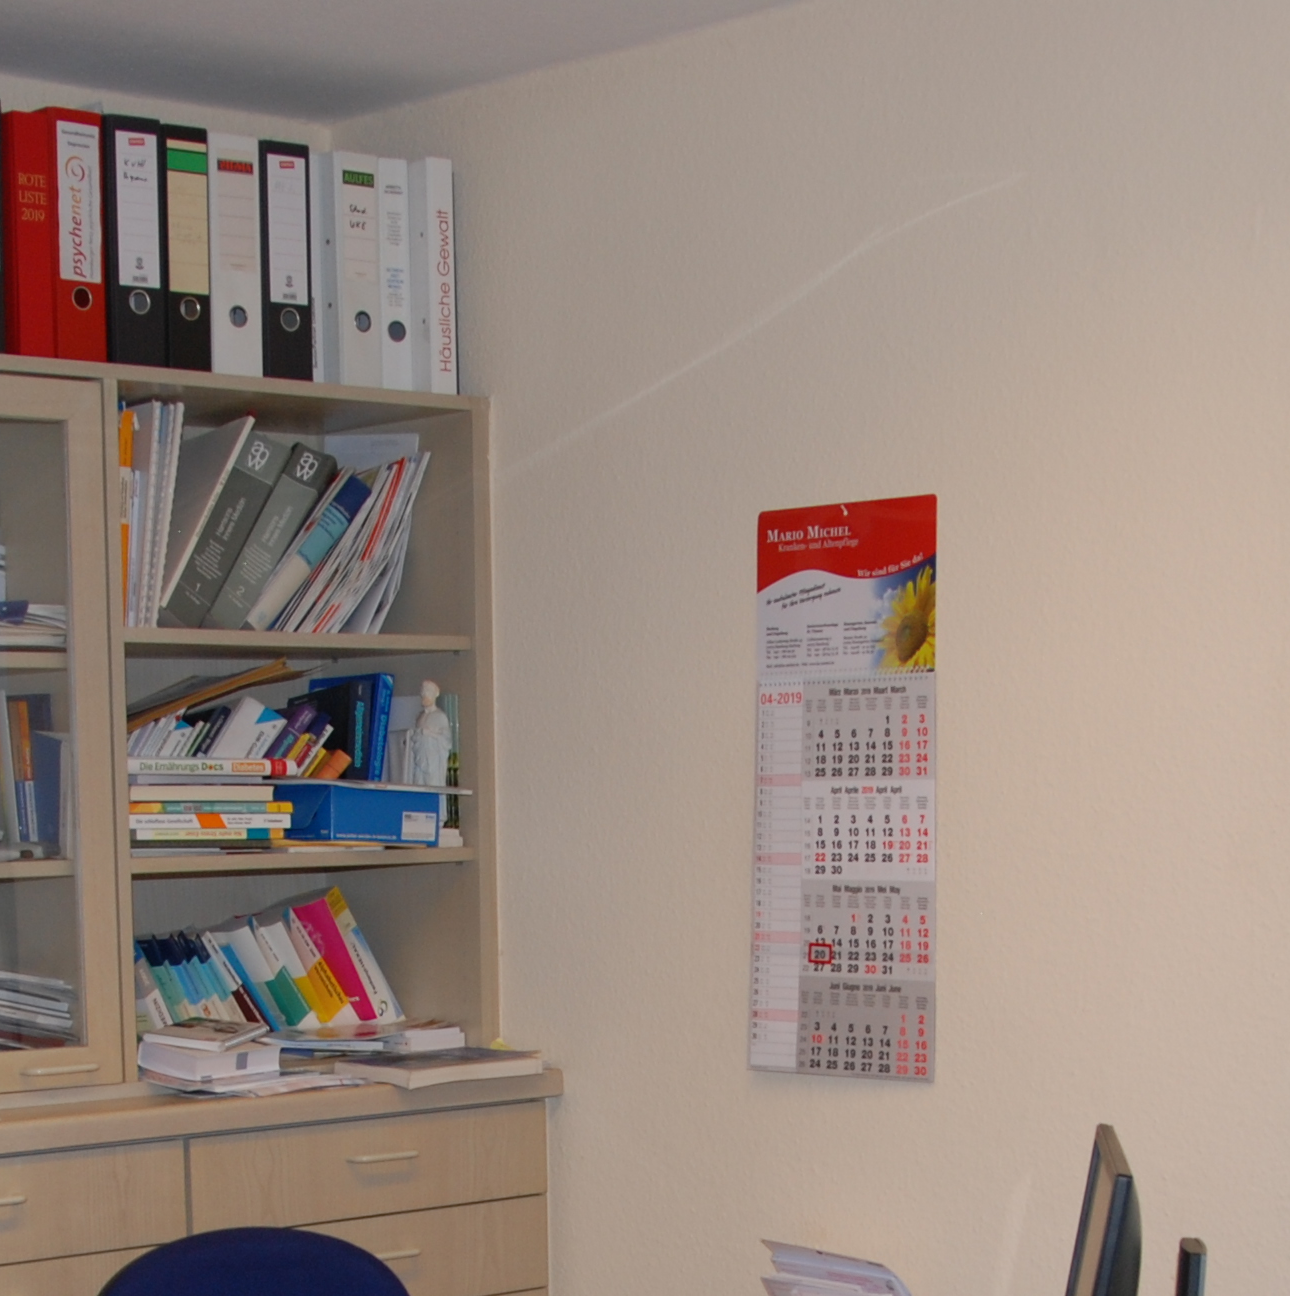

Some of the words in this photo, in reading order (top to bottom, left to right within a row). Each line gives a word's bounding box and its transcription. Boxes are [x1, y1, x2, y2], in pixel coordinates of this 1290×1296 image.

[18, 172, 47, 188] ROTE
[344, 172, 374, 186] AULFES
[19, 190, 47, 205] LISTE
[22, 208, 46, 222] 2019
[69, 185, 87, 279] psychenet
[436, 209, 450, 277] Gewalt
[439, 282, 452, 373] Häusliche
[767, 529, 804, 543] MARIO
[807, 525, 852, 540] MICHEL
[809, 540, 822, 550] und
[823, 538, 859, 550] Altenpflege
[857, 569, 871, 577] Wir
[872, 567, 887, 577] sind
[888, 564, 899, 574] für
[900, 560, 911, 571] Sie
[912, 552, 924, 564] da!
[760, 692, 802, 705] 04-2019
[816, 743, 826, 752] 11
[832, 743, 843, 751] 12
[849, 742, 860, 751] 13
[865, 742, 876, 751] 14
[882, 741, 893, 750] 15
[899, 741, 911, 750] 16
[917, 740, 928, 749] 17
[139, 762, 153, 771] Die
[155, 762, 200, 773] Ernährungs
[233, 762, 265, 772] Diabetes
[815, 767, 826, 777] 25
[831, 767, 843, 777] 26
[848, 767, 859, 777] 27
[864, 767, 876, 776] 28
[881, 766, 893, 776] 29
[899, 766, 911, 775] 30
[916, 766, 928, 775] 31
[831, 786, 842, 795] April
[861, 786, 874, 794] 2019
[876, 786, 888, 794] April
[890, 786, 902, 794] April
[818, 815, 823, 824] 1
[834, 815, 840, 824] 2
[850, 815, 856, 824] 3
[867, 815, 873, 824] 4
[884, 815, 890, 824] 5
[901, 815, 908, 824] 6
[919, 814, 925, 824] 7
[817, 828, 823, 837] 8
[834, 828, 840, 837] 9
[848, 828, 859, 837] 10
[865, 828, 875, 837] 11
[882, 828, 893, 837] 12
[899, 828, 911, 837] 13
[917, 828, 928, 837] 14
[815, 840, 826, 849] 15
[832, 840, 842, 849] 16
[848, 840, 859, 849] 17
[865, 840, 876, 849] 18
[882, 841, 894, 850] 19
[899, 841, 911, 850] 20
[917, 841, 928, 850] 21
[815, 853, 826, 862] 22
[831, 853, 842, 862] 23
[847, 853, 859, 862] 24
[864, 853, 876, 862] 25
[881, 853, 893, 863] 26
[899, 854, 911, 863] 27
[916, 854, 928, 863] 28
[815, 865, 826, 874] 29
[831, 865, 842, 875] 30
[889, 886, 901, 895] May
